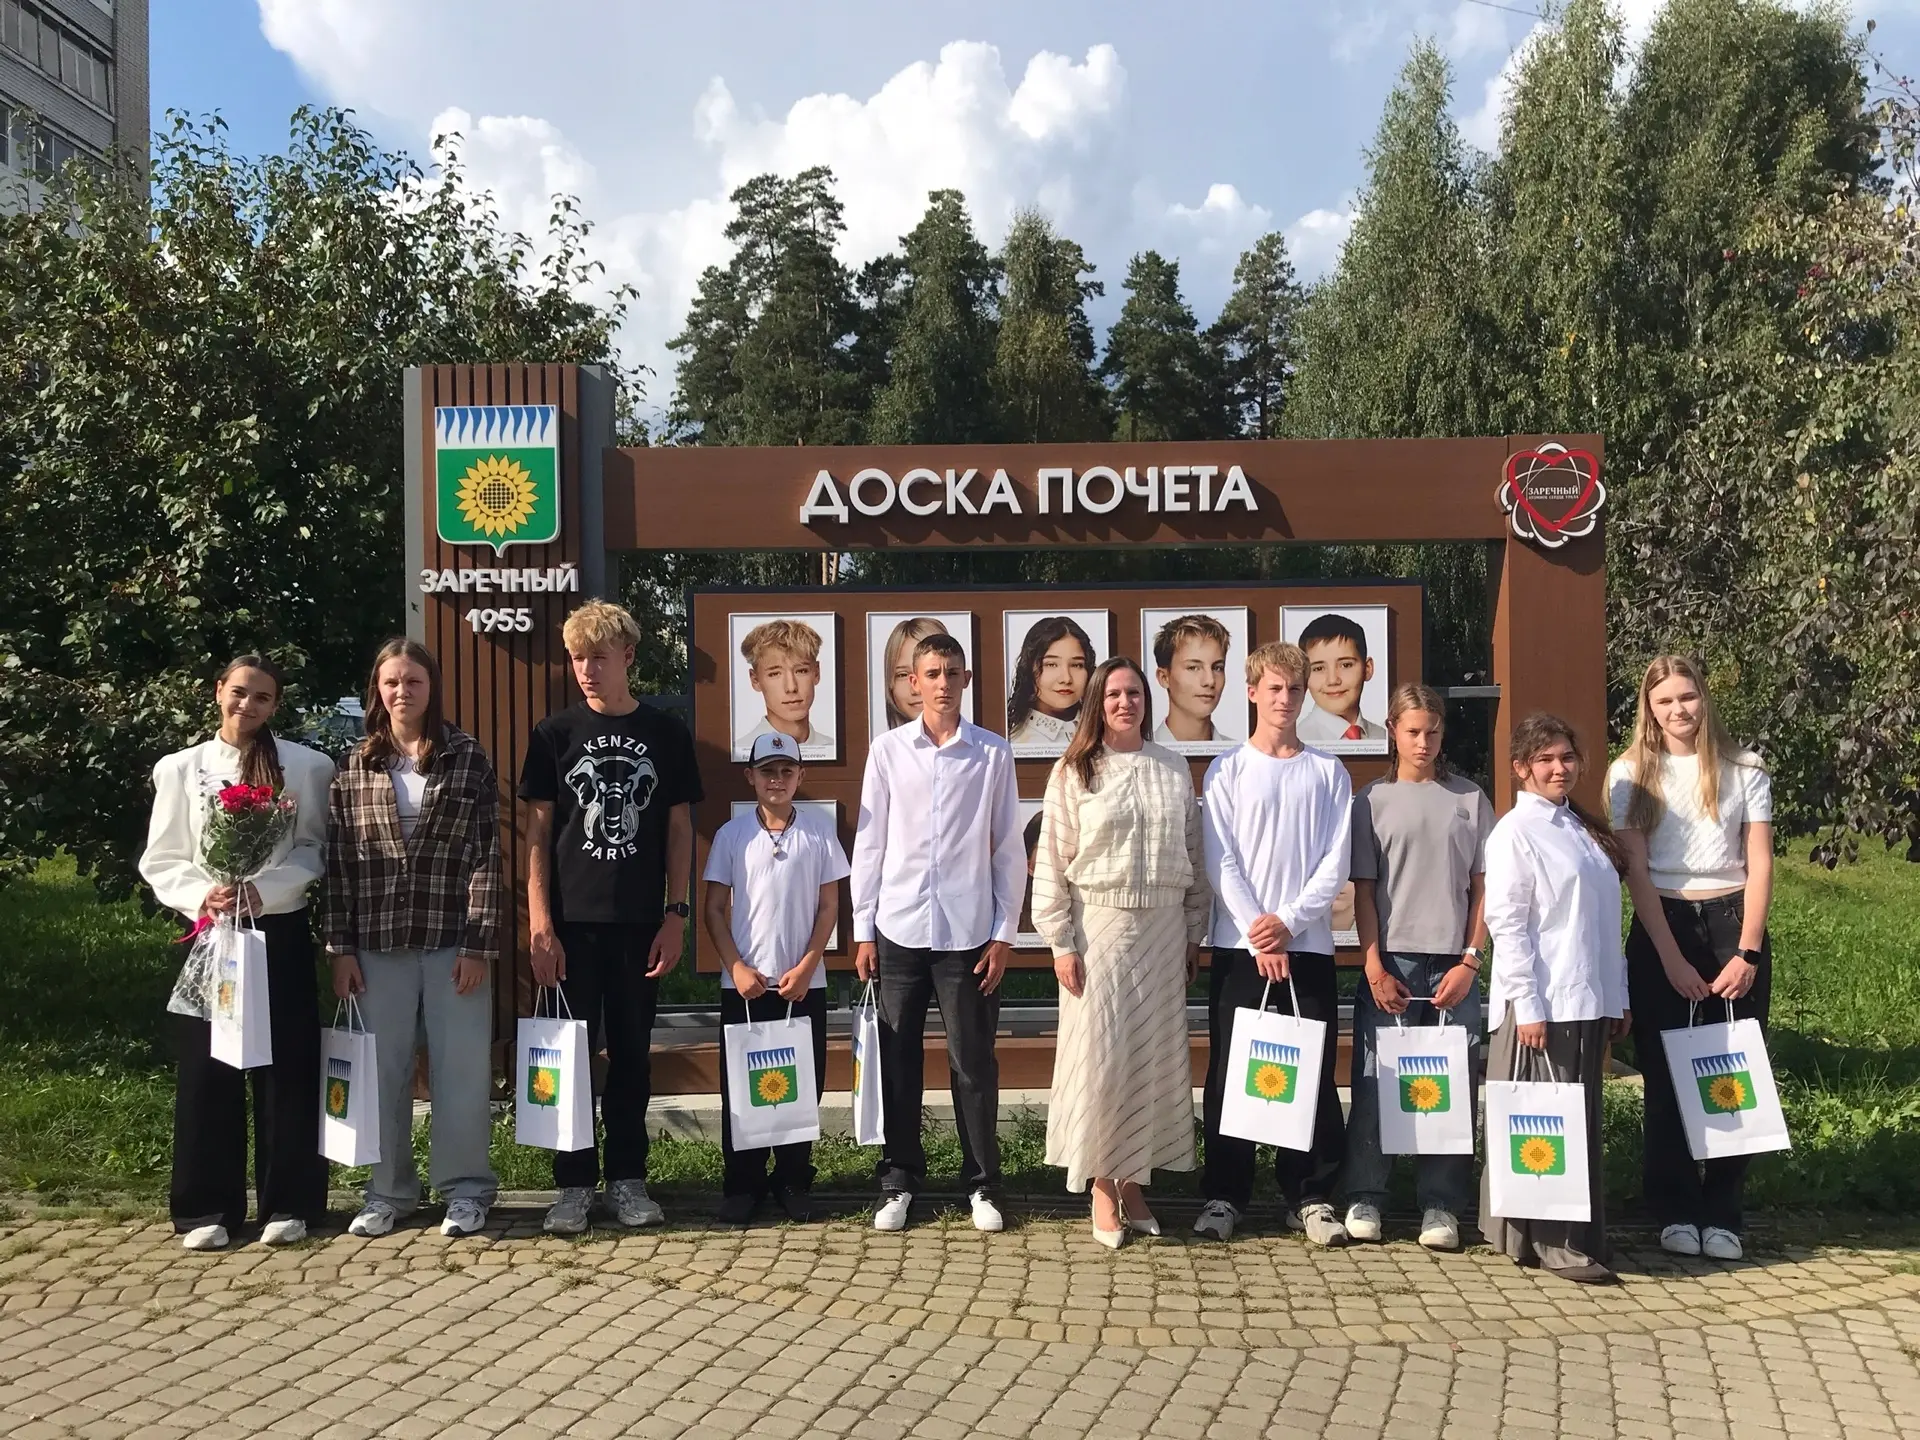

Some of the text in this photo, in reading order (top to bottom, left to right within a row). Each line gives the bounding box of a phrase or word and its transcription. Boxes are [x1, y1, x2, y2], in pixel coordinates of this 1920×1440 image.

[799, 465, 1259, 524] ДОСКА ПОЧЕТА
[1528, 485, 1579, 495] ЗАРЕЧНЫЙ
[419, 562, 579, 593] ЗАРЕЧНЫЙ
[465, 608, 534, 633] 1955
[583, 735, 648, 756] KENZO
[582, 840, 637, 860] PARIS
